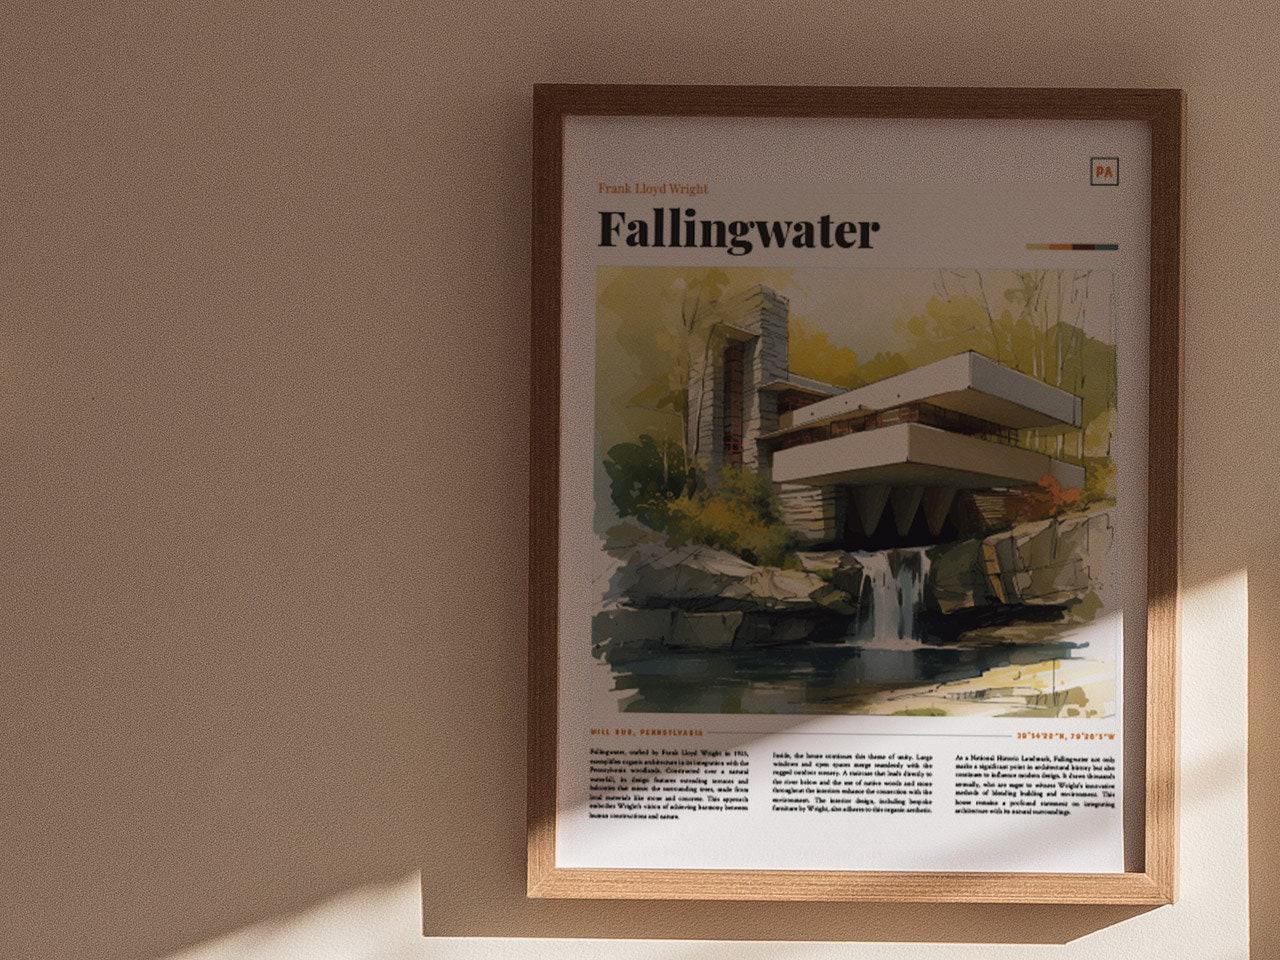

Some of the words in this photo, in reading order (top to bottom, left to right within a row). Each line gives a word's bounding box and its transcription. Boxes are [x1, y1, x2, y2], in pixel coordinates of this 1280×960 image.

[1096, 166, 1112, 177] PA
[599, 183, 631, 194] Frank
[635, 183, 666, 196] Lloyd
[668, 184, 709, 196] Wright
[598, 208, 880, 256] Fallingwater
